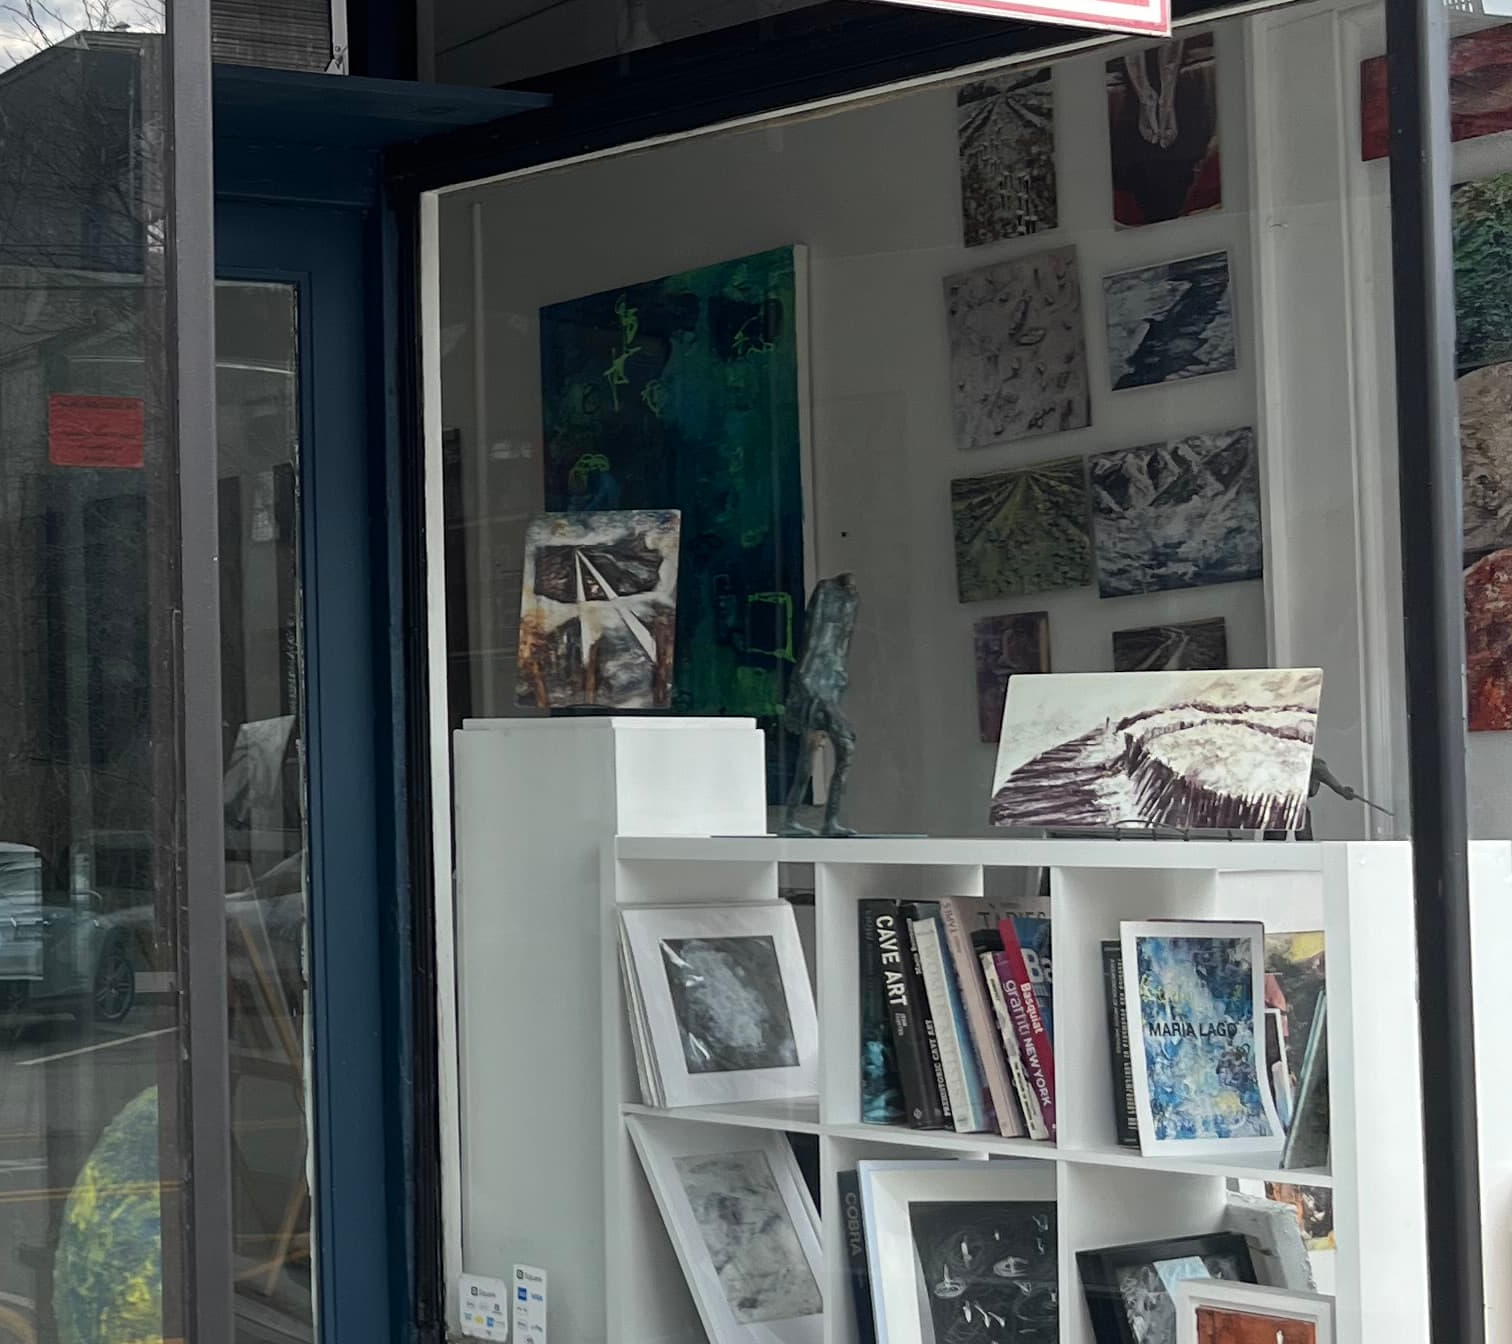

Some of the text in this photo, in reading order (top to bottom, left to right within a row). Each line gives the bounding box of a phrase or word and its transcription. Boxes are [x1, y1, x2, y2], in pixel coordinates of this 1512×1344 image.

[875, 914, 908, 1006] CAVE ART
[1020, 982, 1045, 1034] Basquiat
[1149, 1022, 1237, 1037] MARIA LAGO
[1003, 980, 1030, 1036] graffiti
[1023, 1036, 1039, 1069] NEW
[1033, 1067, 1051, 1106] YORK
[845, 1192, 862, 1256] COBRA
